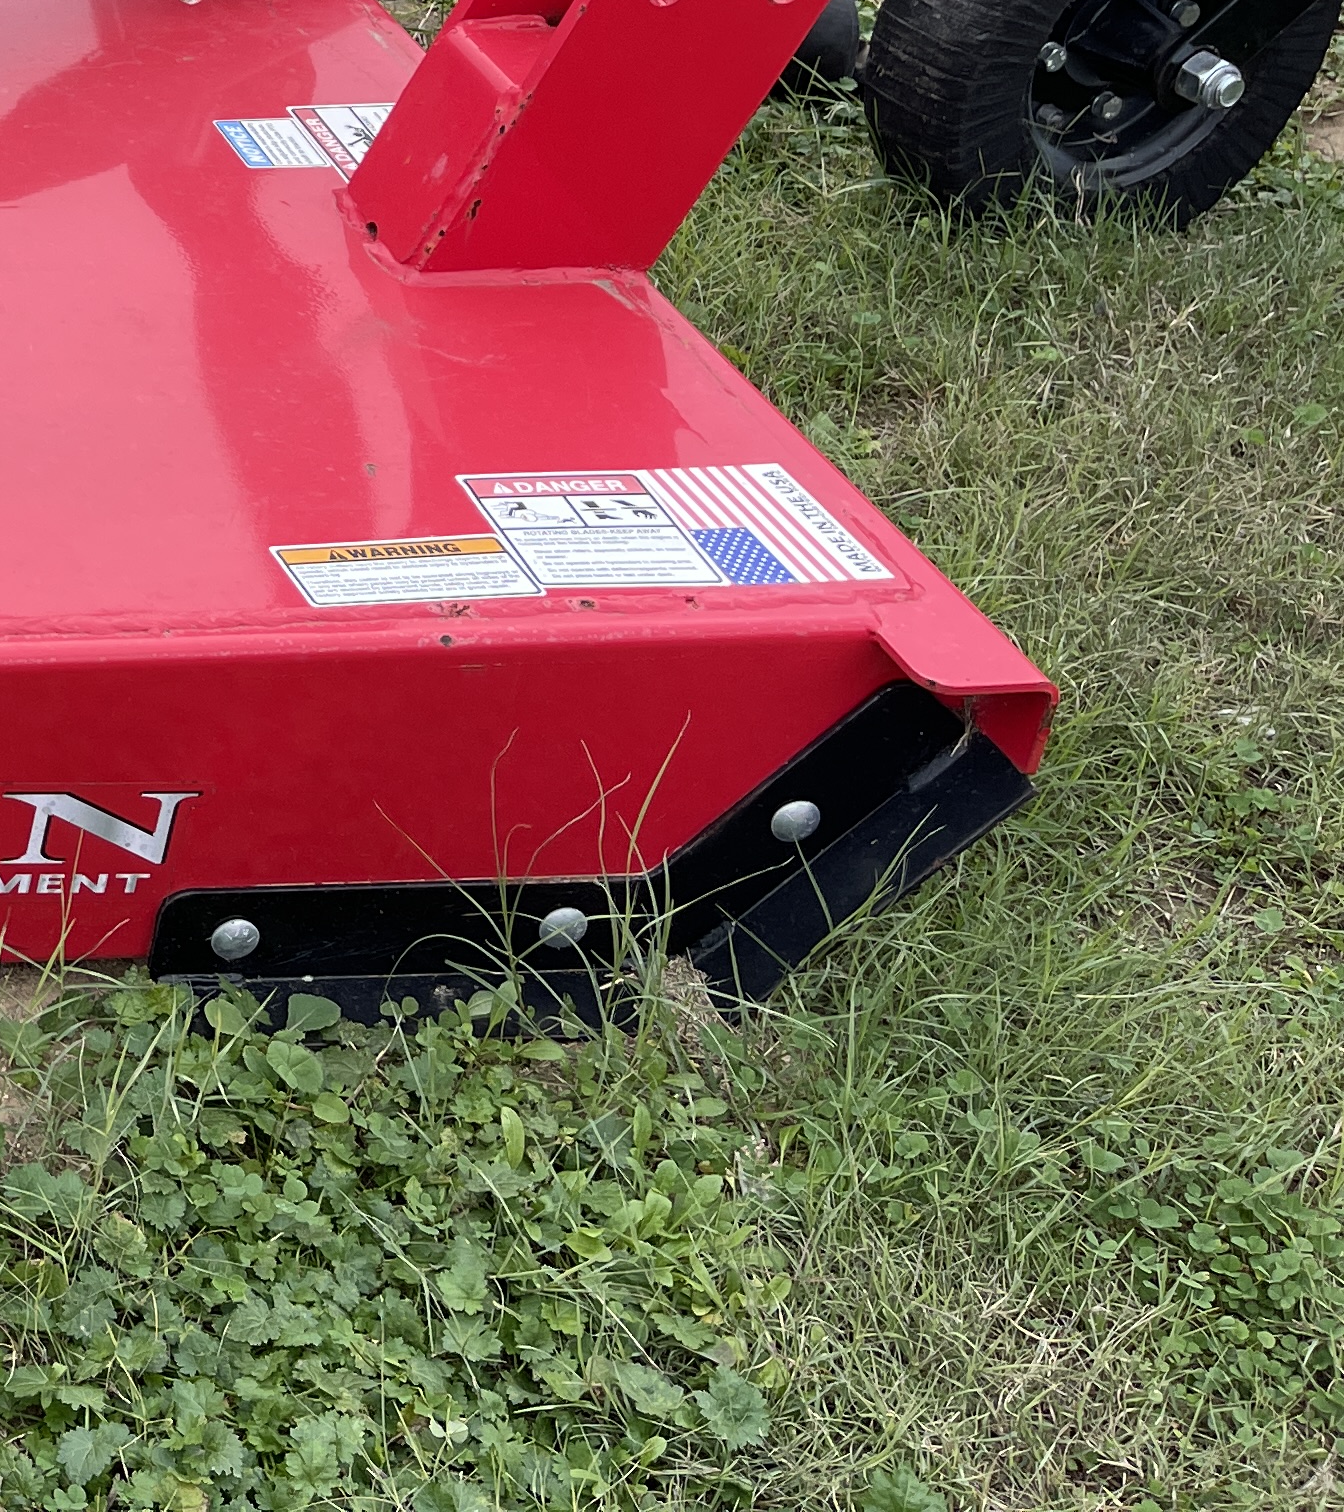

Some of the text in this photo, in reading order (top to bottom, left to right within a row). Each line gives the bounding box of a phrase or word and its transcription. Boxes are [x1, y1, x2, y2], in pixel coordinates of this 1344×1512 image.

[224, 125, 267, 163] NOTICE
[306, 118, 351, 162] DANGER
[512, 479, 627, 494] DANGER
[762, 470, 796, 494] USA
[786, 497, 820, 519] THE
[345, 543, 461, 559] WARNING
[828, 537, 877, 572] MADE
